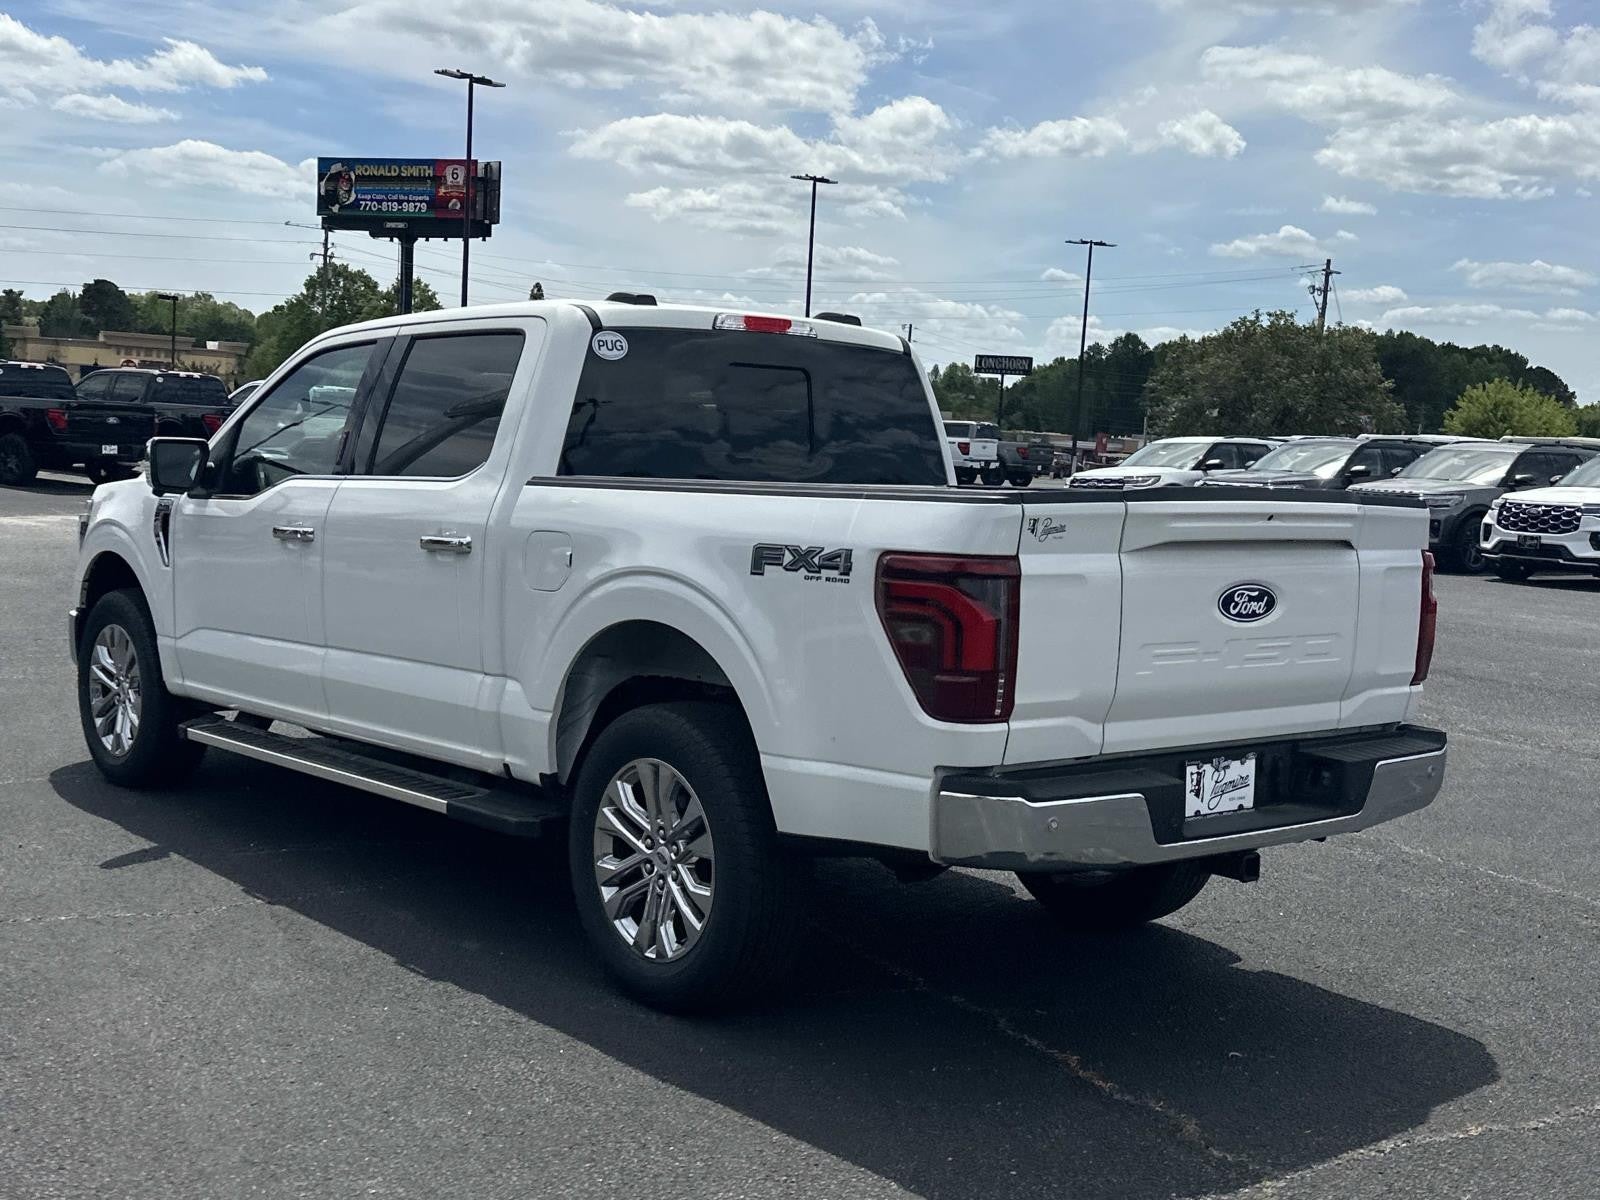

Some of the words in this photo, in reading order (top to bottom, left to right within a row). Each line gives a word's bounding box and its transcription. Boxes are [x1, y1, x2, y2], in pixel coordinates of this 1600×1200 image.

[355, 164, 399, 176] RONALD
[401, 165, 433, 177] SMITH
[451, 168, 459, 180] 6
[360, 201, 427, 212] 770-819-9879
[597, 339, 624, 351] PUG
[976, 355, 1029, 370] LONGHORN
[750, 543, 853, 576] FX4
[825, 576, 850, 584] ROAD
[1230, 590, 1267, 615] Ford
